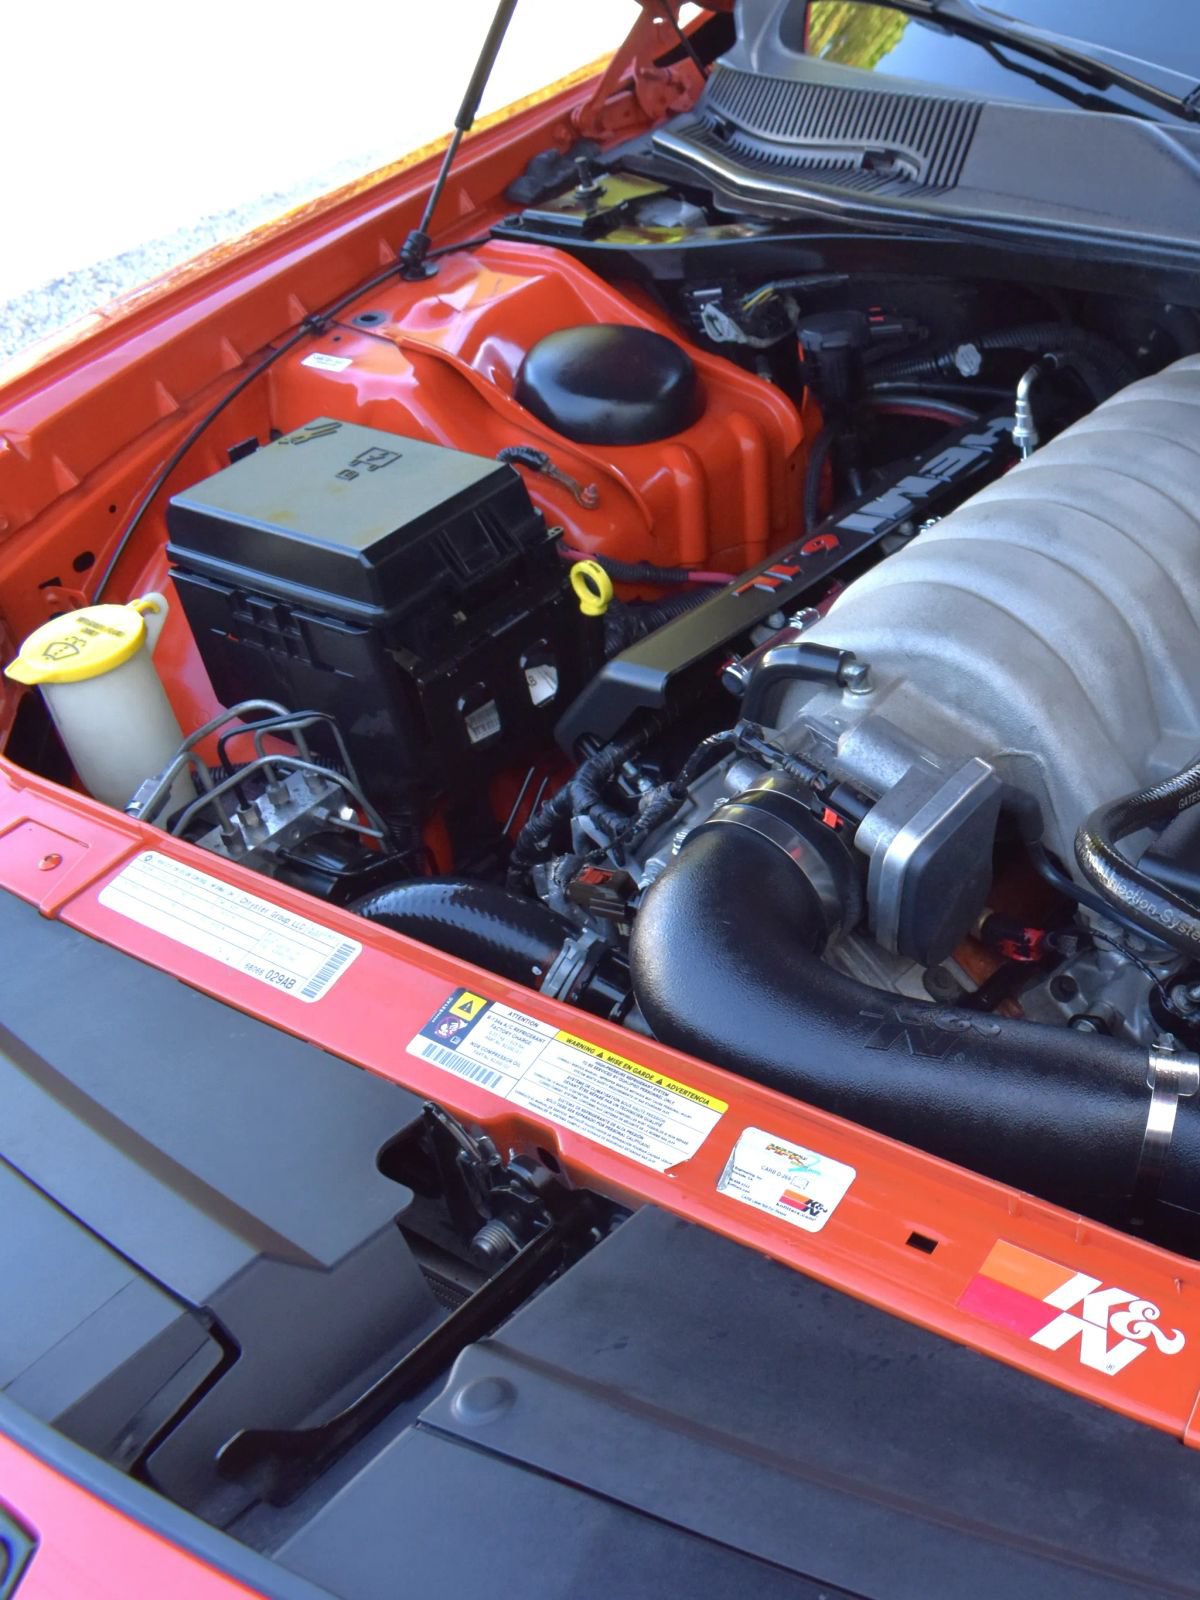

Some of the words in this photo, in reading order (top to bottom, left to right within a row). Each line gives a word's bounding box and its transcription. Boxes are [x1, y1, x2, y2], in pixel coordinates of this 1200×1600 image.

[270, 911, 291, 924] Group
[291, 920, 306, 930] LLC
[265, 969, 297, 990] 029AB
[507, 1011, 540, 1027] ATTENTION
[566, 1038, 595, 1053] WARNING
[606, 1056, 622, 1065] MISE
[632, 1067, 654, 1080] GARDE
[665, 1082, 710, 1104] ADVERTENCIA
[761, 1165, 777, 1177] CARB
[803, 1198, 828, 1217] K&N
[1029, 1271, 1186, 1377] K&N
